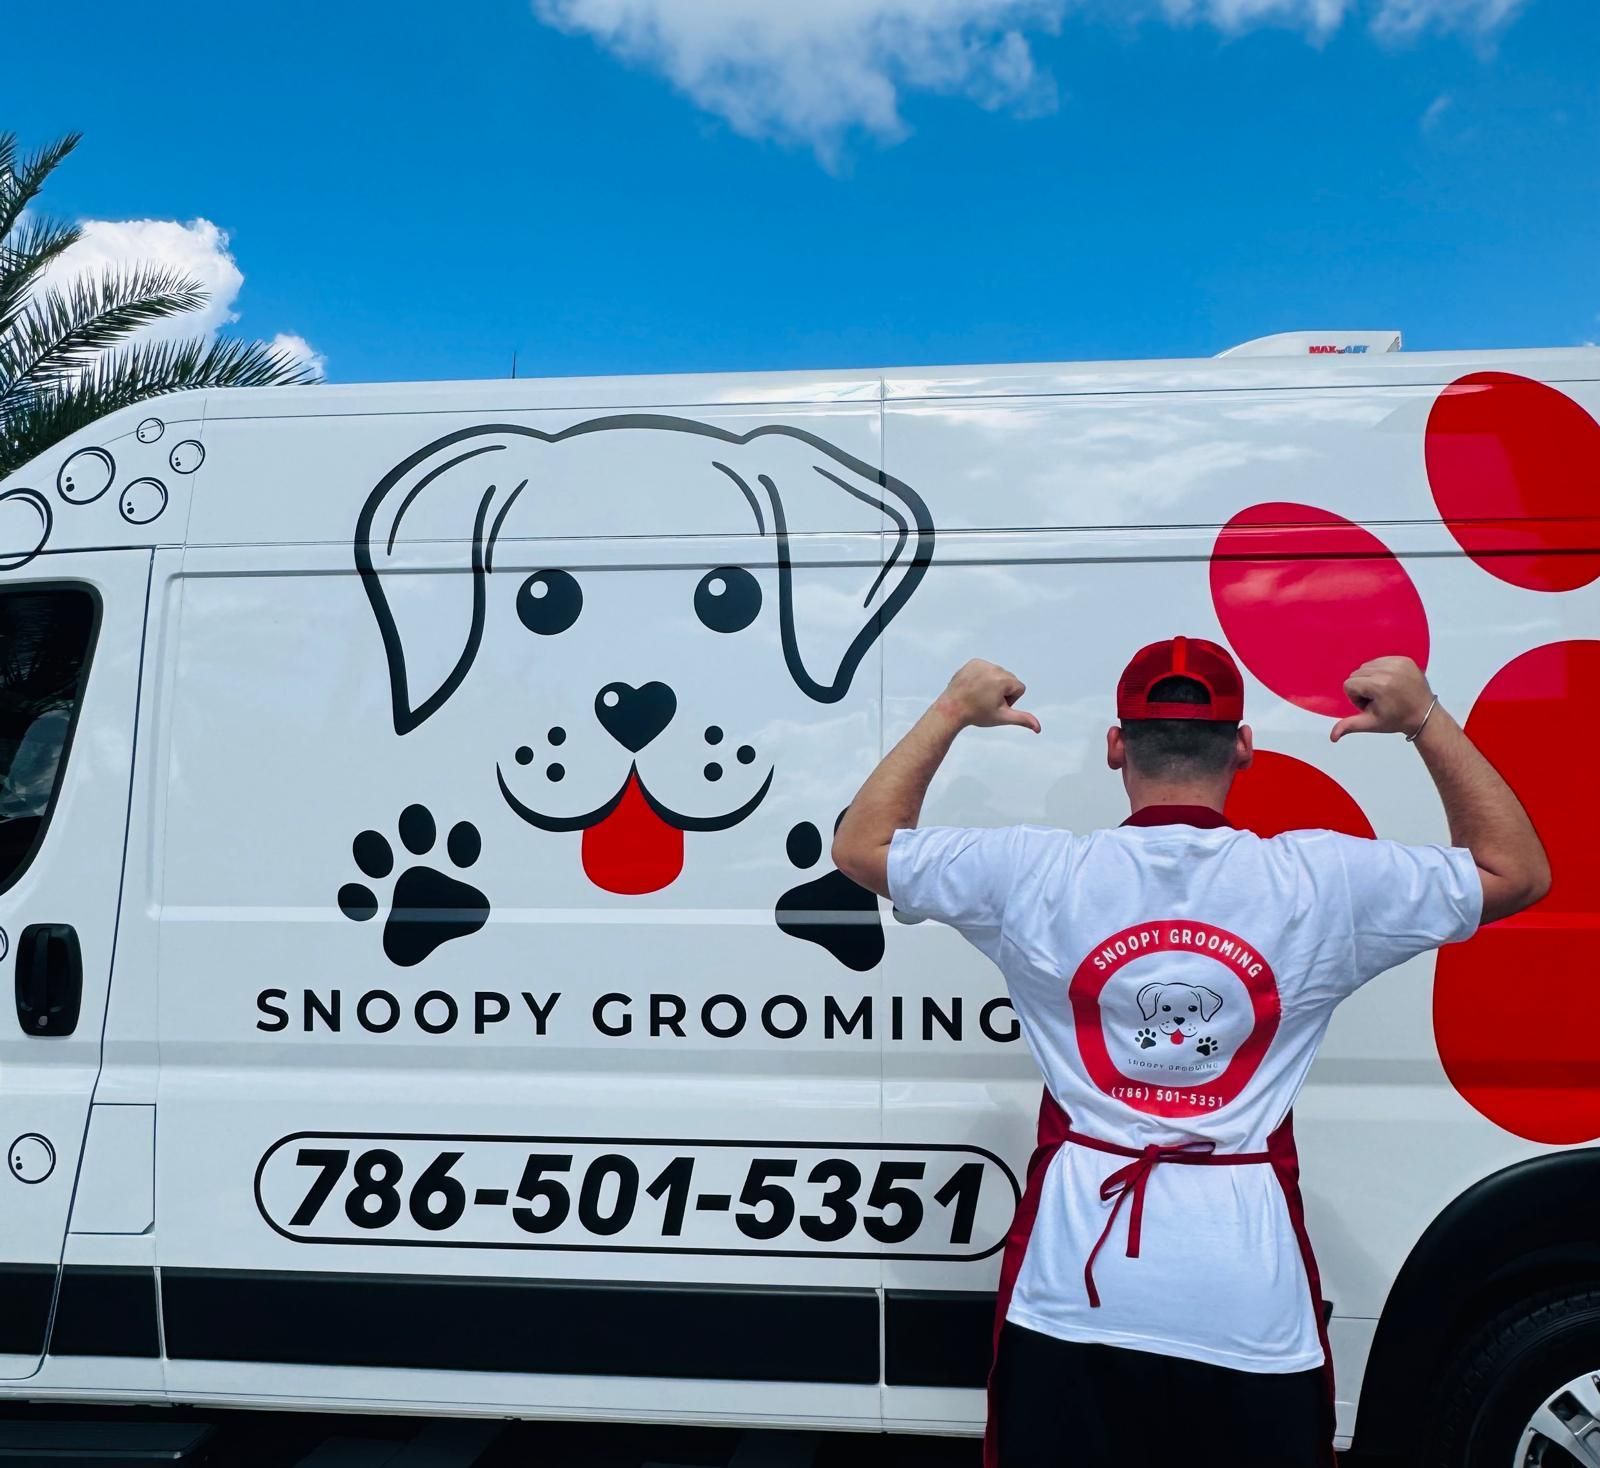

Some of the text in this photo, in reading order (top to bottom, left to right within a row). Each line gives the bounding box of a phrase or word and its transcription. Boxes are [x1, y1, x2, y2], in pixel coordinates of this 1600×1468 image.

[1093, 929, 1263, 978] SNOOPY GROOMING
[256, 988, 1021, 1043] SNOOPY GROOMING
[1111, 1086, 1224, 1107] (786) 501-5351
[287, 1148, 985, 1245] 786-501-5351
